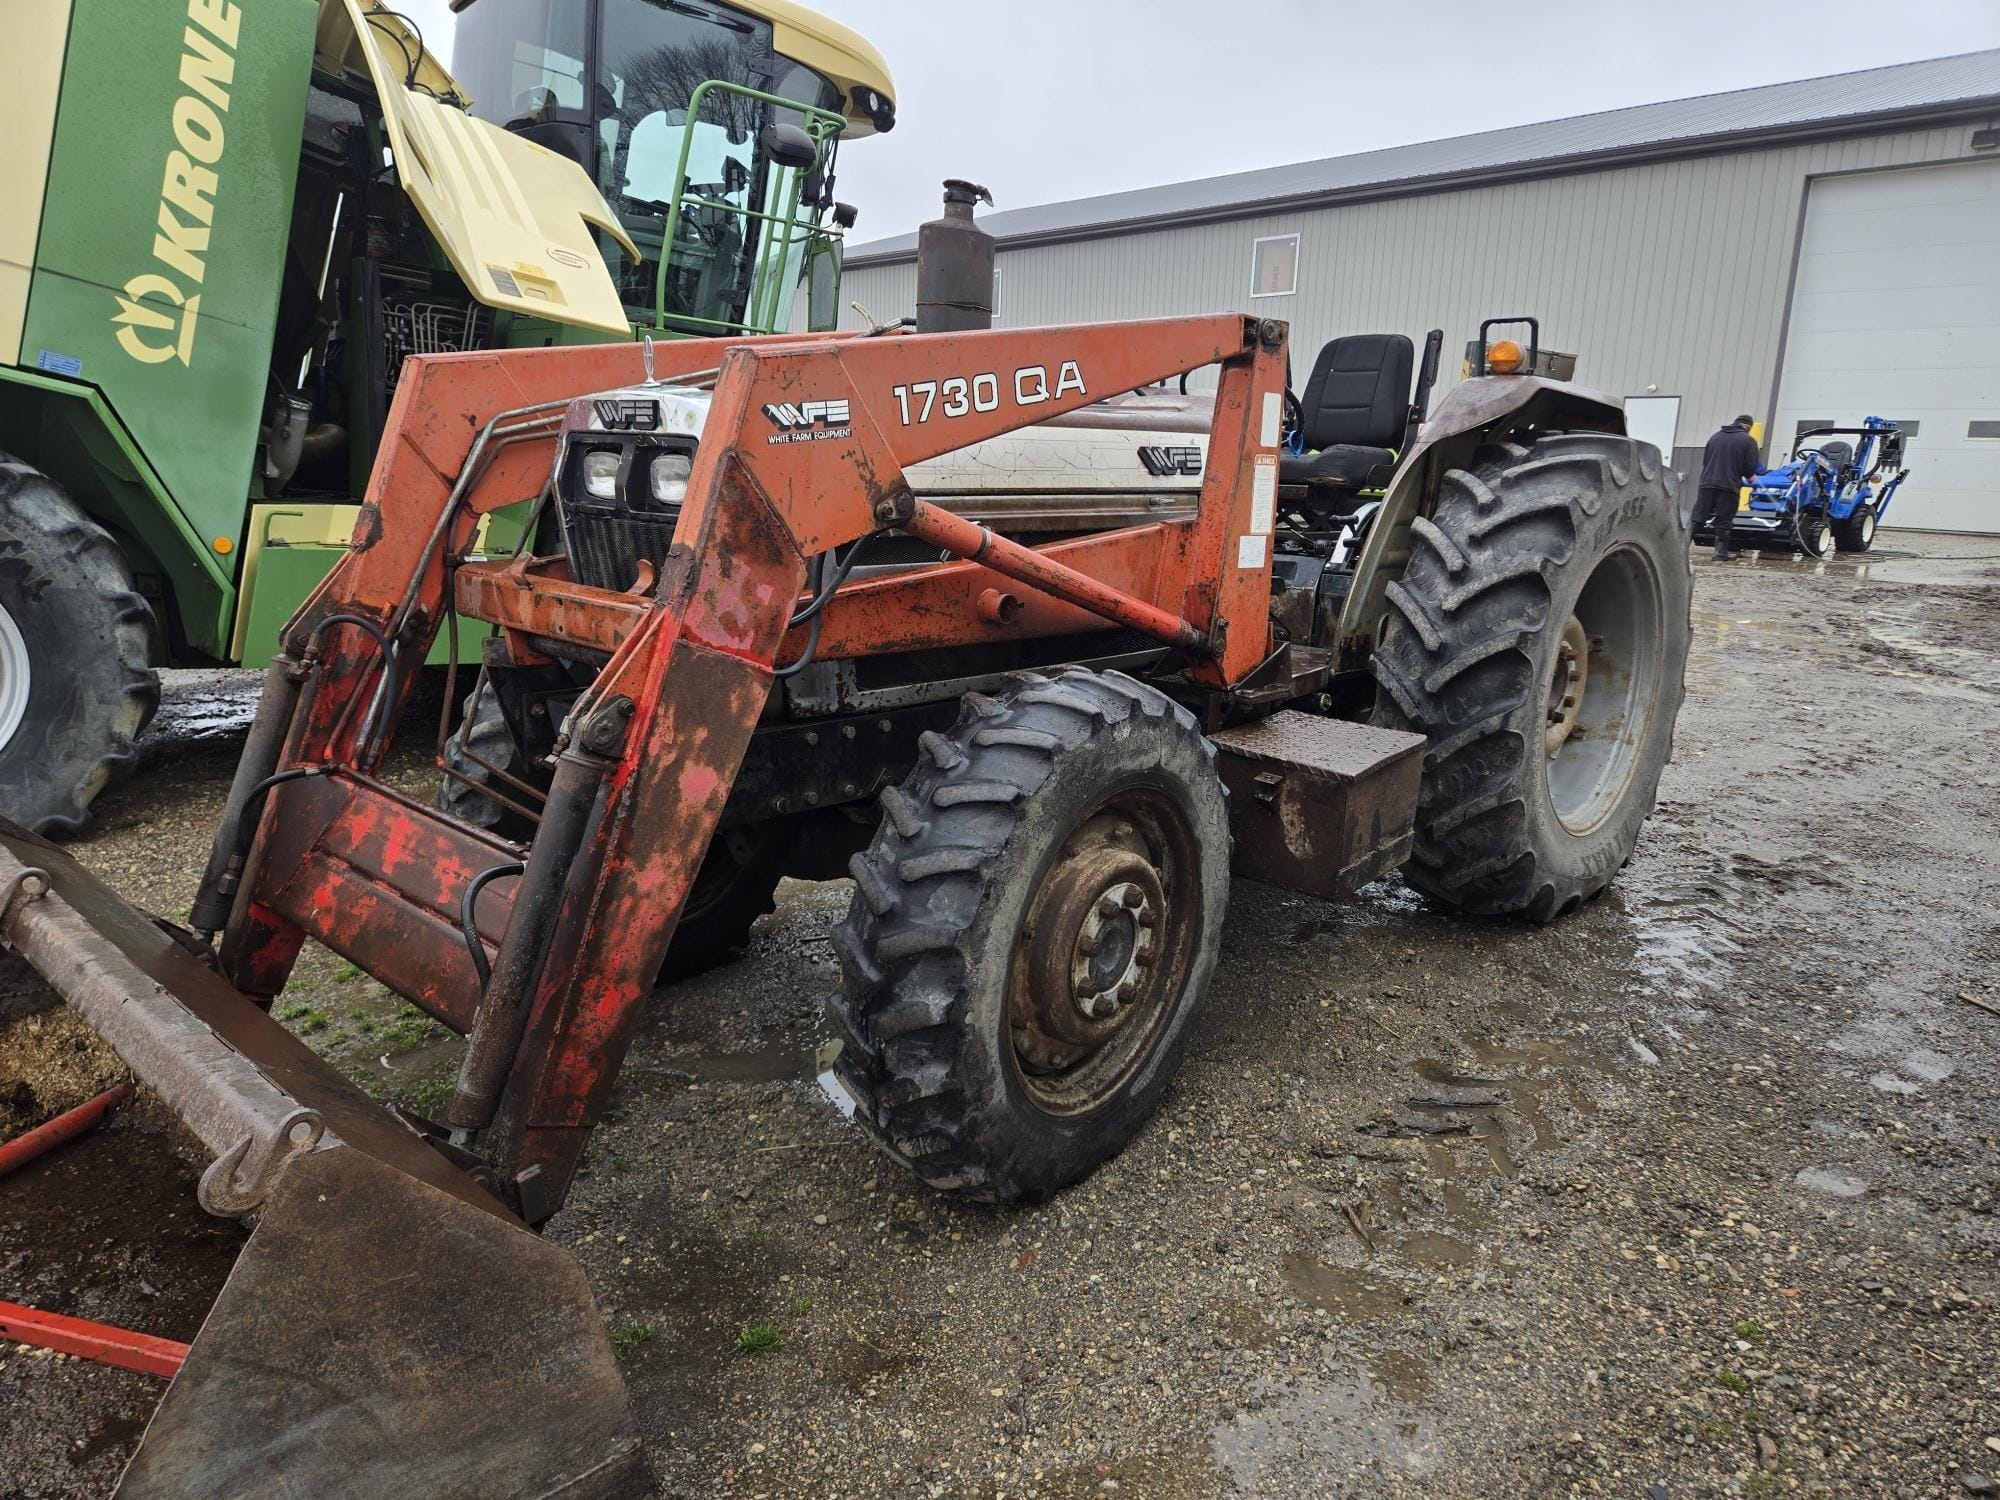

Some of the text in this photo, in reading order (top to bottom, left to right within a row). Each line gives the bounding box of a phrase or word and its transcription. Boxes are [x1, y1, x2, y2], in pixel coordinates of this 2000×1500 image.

[153, 0, 242, 284] KRONE
[893, 360, 1088, 426] 1730 QA
[593, 400, 659, 430] WFE
[761, 399, 850, 432] WFE
[767, 428, 852, 445] WHITE FARM EQUIPMENT
[1137, 447, 1202, 475] WFE
